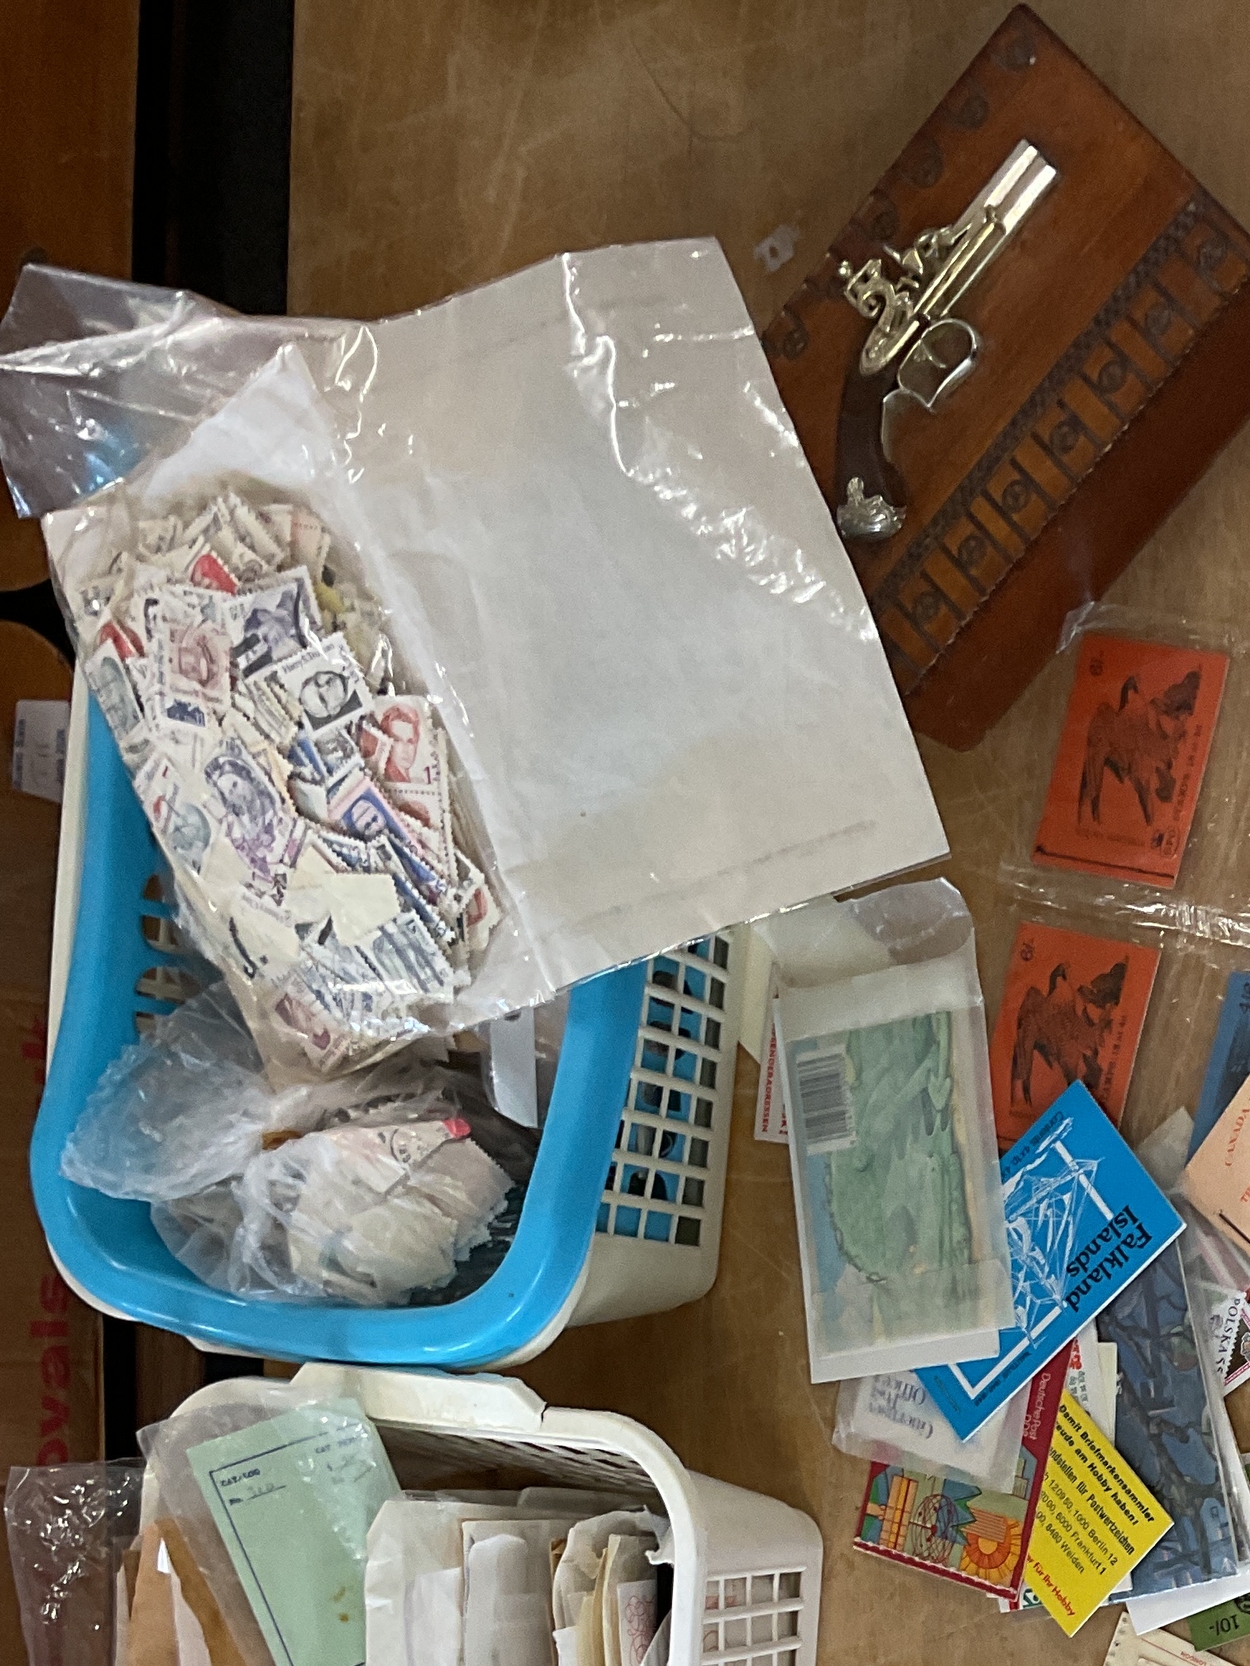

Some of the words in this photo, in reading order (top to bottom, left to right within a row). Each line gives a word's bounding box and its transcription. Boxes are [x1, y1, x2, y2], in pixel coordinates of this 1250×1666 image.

[1225, 1108, 1250, 1167] CANADA
[1066, 1205, 1139, 1277] Islands
[1066, 1223, 1152, 1312] Falkland
[1034, 1372, 1052, 1420] Deutsche
[1029, 1419, 1042, 1441] Post
[1059, 1404, 1081, 1434] Damit
[1081, 1428, 1155, 1523] Briefmarkensammler
[1075, 1447, 1088, 1465] am
[1088, 1462, 1112, 1495] Hobby
[1111, 1488, 1139, 1525] haben!
[1056, 1515, 1073, 1534] 6000
[1070, 1529, 1101, 1570] Frankfurt
[1073, 1510, 1090, 1531] 1000
[1088, 1526, 1107, 1555] Berlin
[1108, 1551, 1119, 1567] 12
[1077, 1477, 1089, 1497] für
[1086, 1490, 1136, 1556] Postwertzeichen
[1060, 1540, 1085, 1575] Weiden
[1032, 1561, 1045, 1579] für
[1043, 1573, 1056, 1590] Ihr
[1052, 1583, 1076, 1617] Hobby
[1208, 1614, 1241, 1638] 10/-
